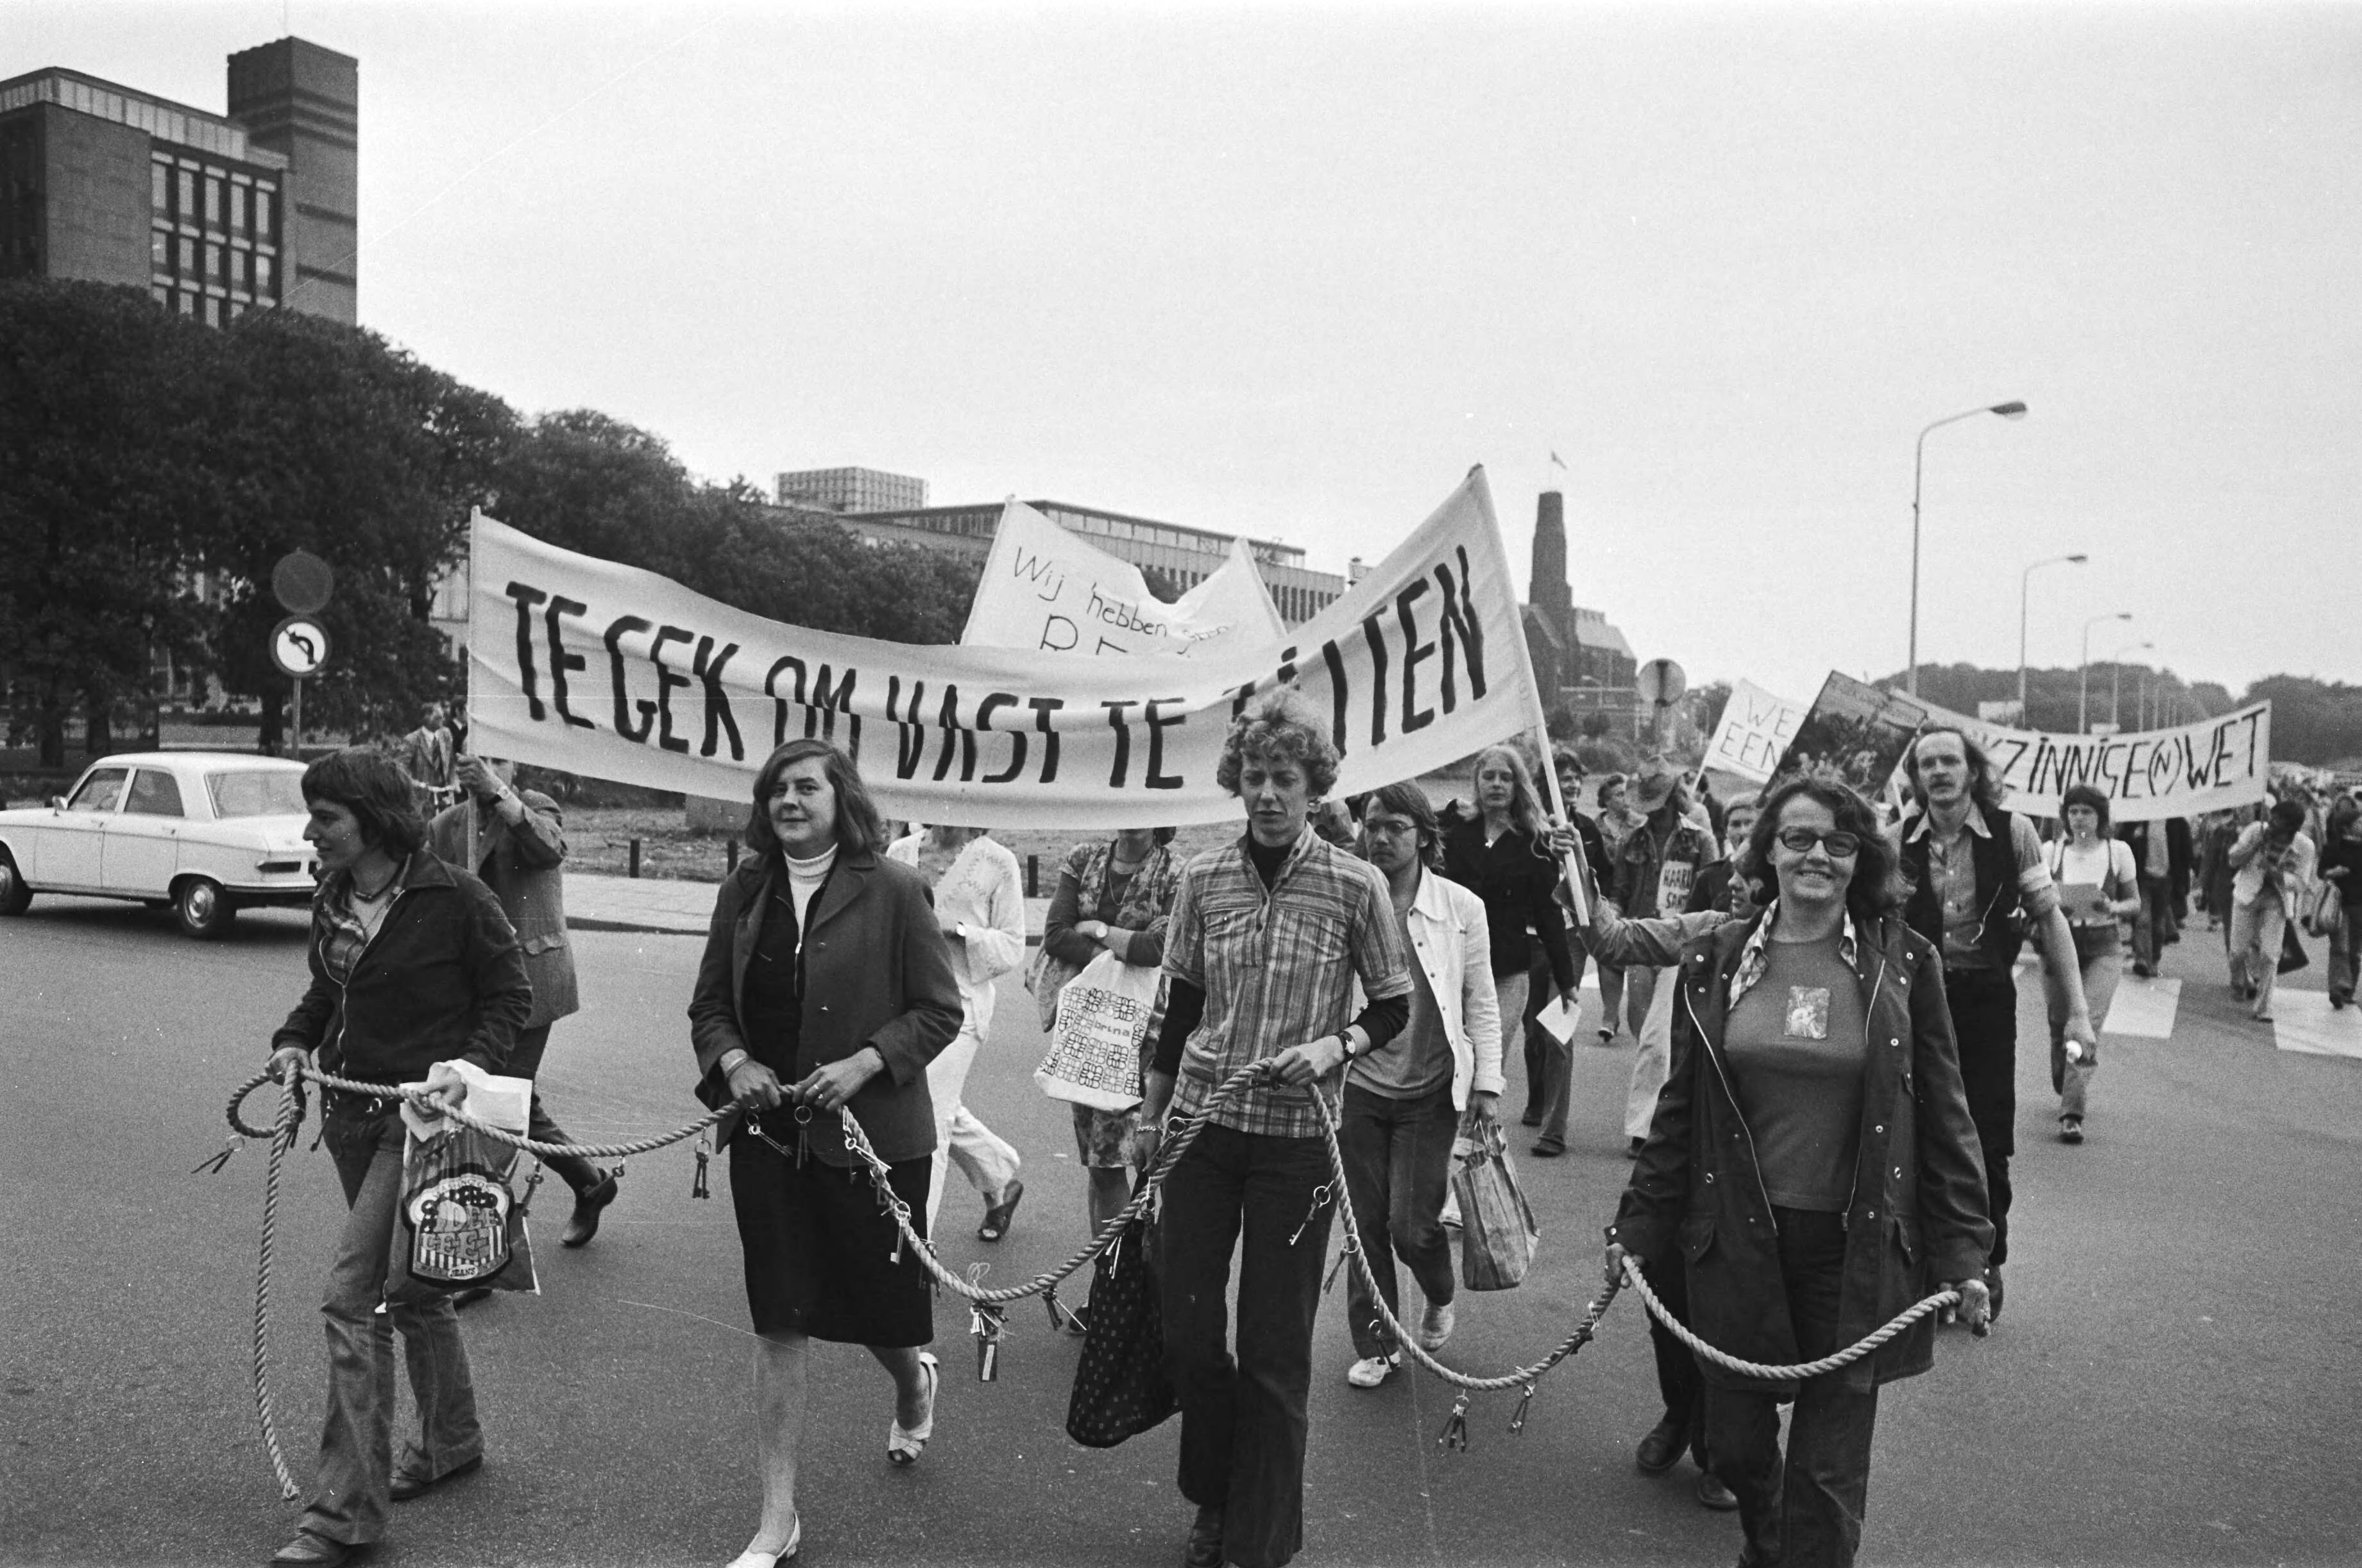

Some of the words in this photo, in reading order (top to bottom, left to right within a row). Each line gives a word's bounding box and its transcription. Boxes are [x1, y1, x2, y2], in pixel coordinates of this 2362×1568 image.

[1014, 546, 1066, 602] Wij
[1087, 582, 1168, 638] hebben
[506, 580, 595, 730] TE
[603, 614, 745, 761] GEK
[765, 655, 862, 767] OM
[886, 675, 1065, 784] VAST
[1100, 697, 1186, 789] TE
[1746, 694, 1796, 739] WE
[1991, 708, 2266, 799] ZINNIGE(N)WET
[1094, 1020, 1130, 1037] brina
[450, 1267, 476, 1277] JEANS
